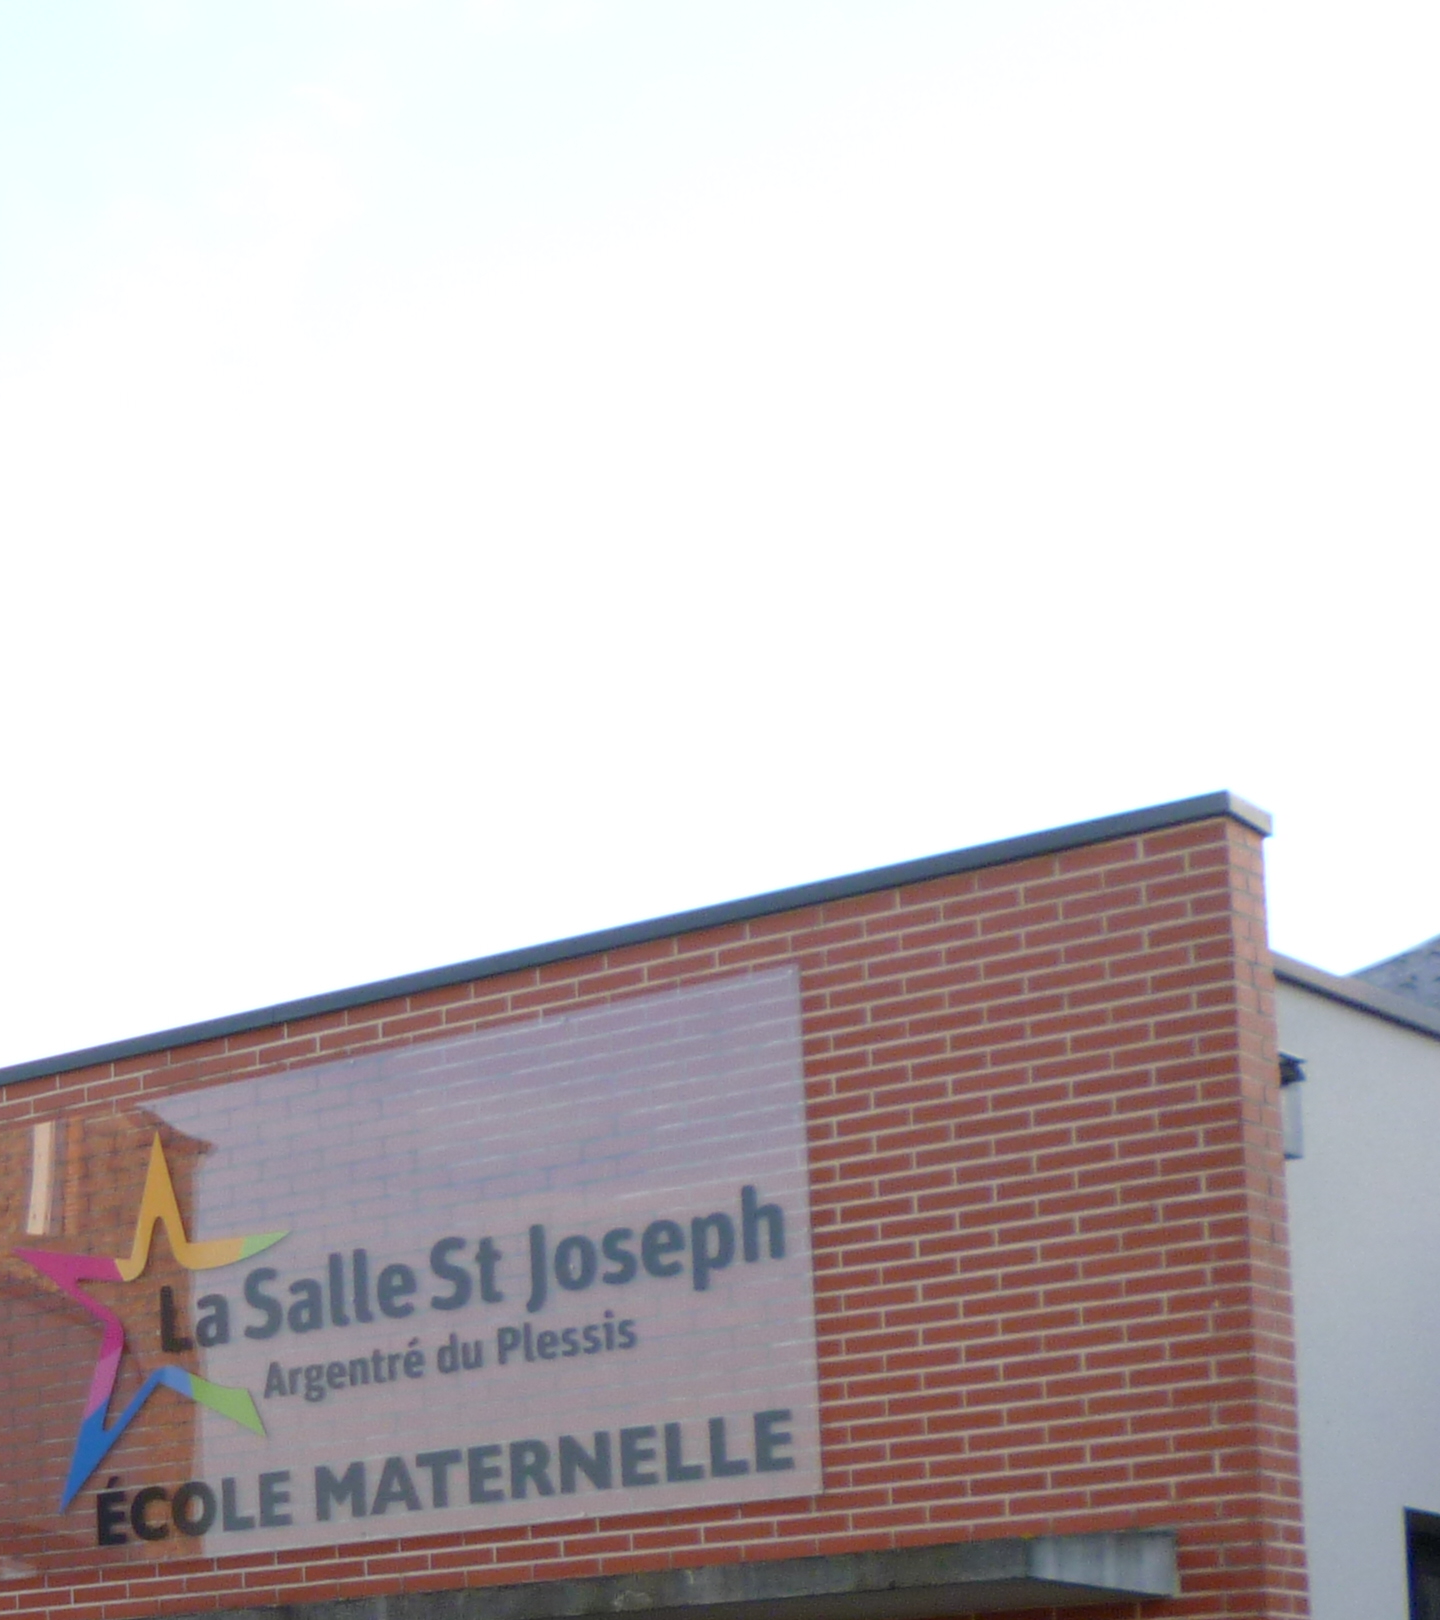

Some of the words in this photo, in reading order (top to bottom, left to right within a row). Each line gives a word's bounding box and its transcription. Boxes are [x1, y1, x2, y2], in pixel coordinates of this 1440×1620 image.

[160, 1285, 230, 1353] La
[244, 1248, 417, 1340] Salle
[429, 1236, 504, 1311] St
[526, 1184, 786, 1313] Joseph
[264, 1337, 425, 1402] Argentré
[437, 1332, 483, 1374] du
[497, 1310, 638, 1365] Plessis
[96, 1469, 294, 1546] ÉCOLE
[314, 1408, 796, 1523] MATERNELLE
